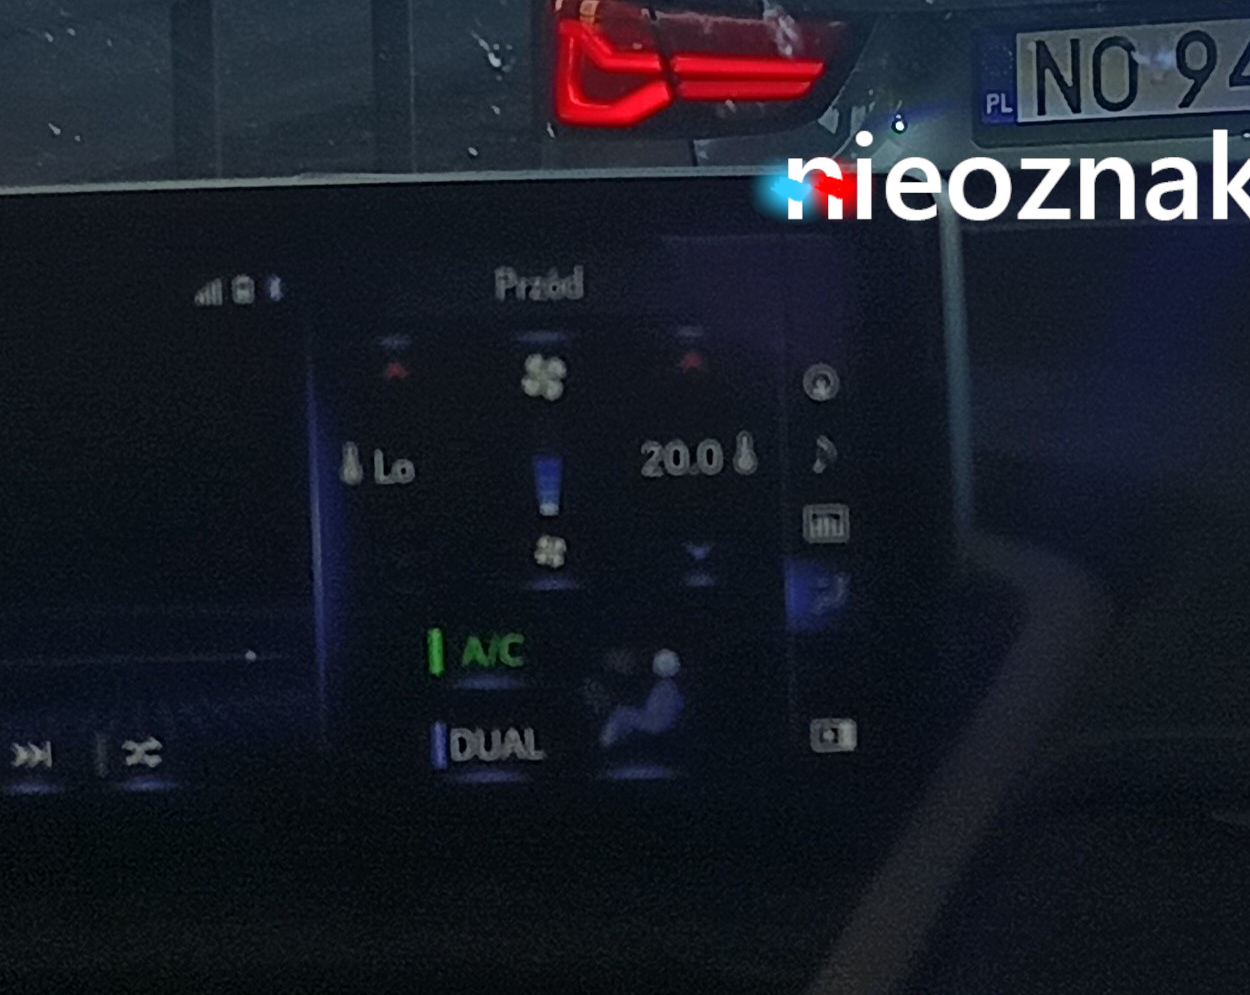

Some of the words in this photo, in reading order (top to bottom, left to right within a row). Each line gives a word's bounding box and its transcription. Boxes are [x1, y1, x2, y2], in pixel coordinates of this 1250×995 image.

[1034, 34, 1140, 117] NO
[985, 92, 1013, 115] PL
[494, 265, 585, 302] Przód
[373, 447, 416, 485] Lo
[640, 438, 725, 478] 20.0
[461, 630, 526, 668] A/C
[449, 726, 547, 762] DUAL
